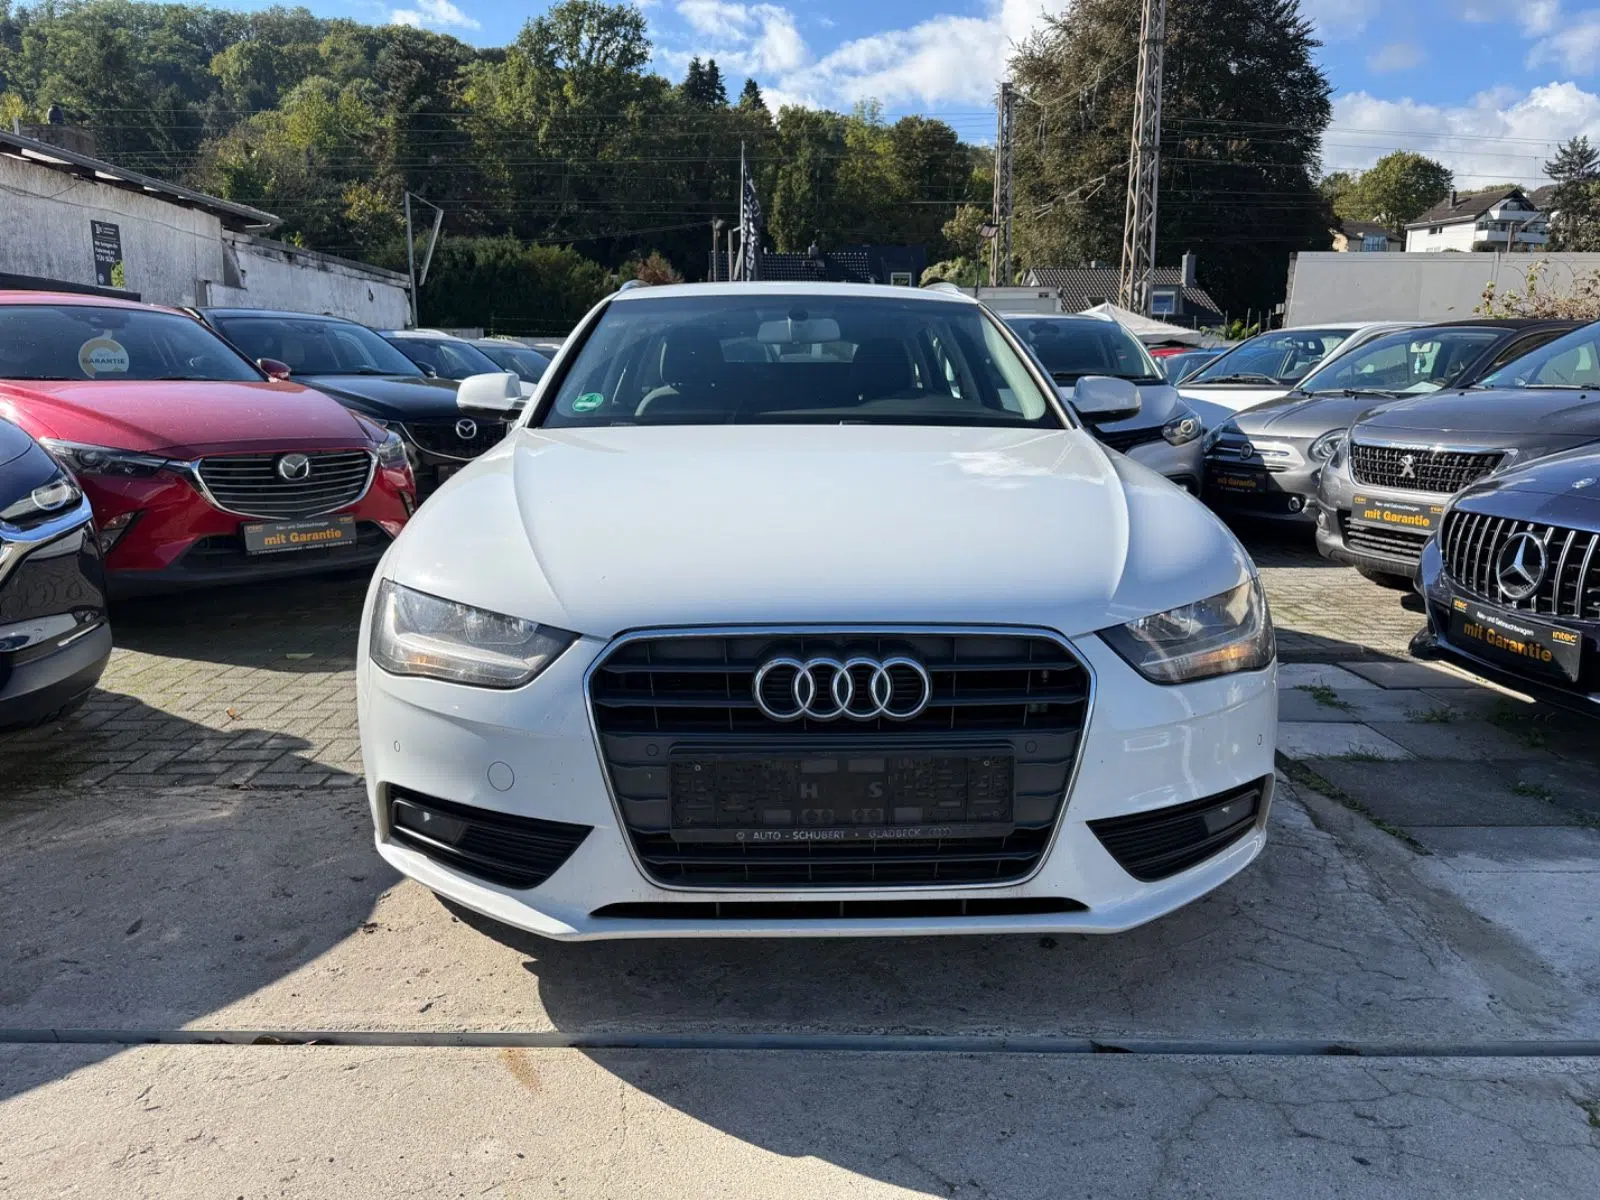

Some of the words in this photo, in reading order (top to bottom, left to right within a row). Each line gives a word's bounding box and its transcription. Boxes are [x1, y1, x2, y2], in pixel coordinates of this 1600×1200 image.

[1364, 509, 1381, 520] mit
[1383, 511, 1430, 527] Garantie
[264, 533, 287, 545] mit
[289, 528, 342, 543] Garantie
[1464, 623, 1483, 639] mit
[1486, 628, 1553, 662] Garantie
[752, 831, 781, 841] AUTO
[792, 830, 845, 840] SCHUBERT
[868, 828, 921, 838] GLADBECK
